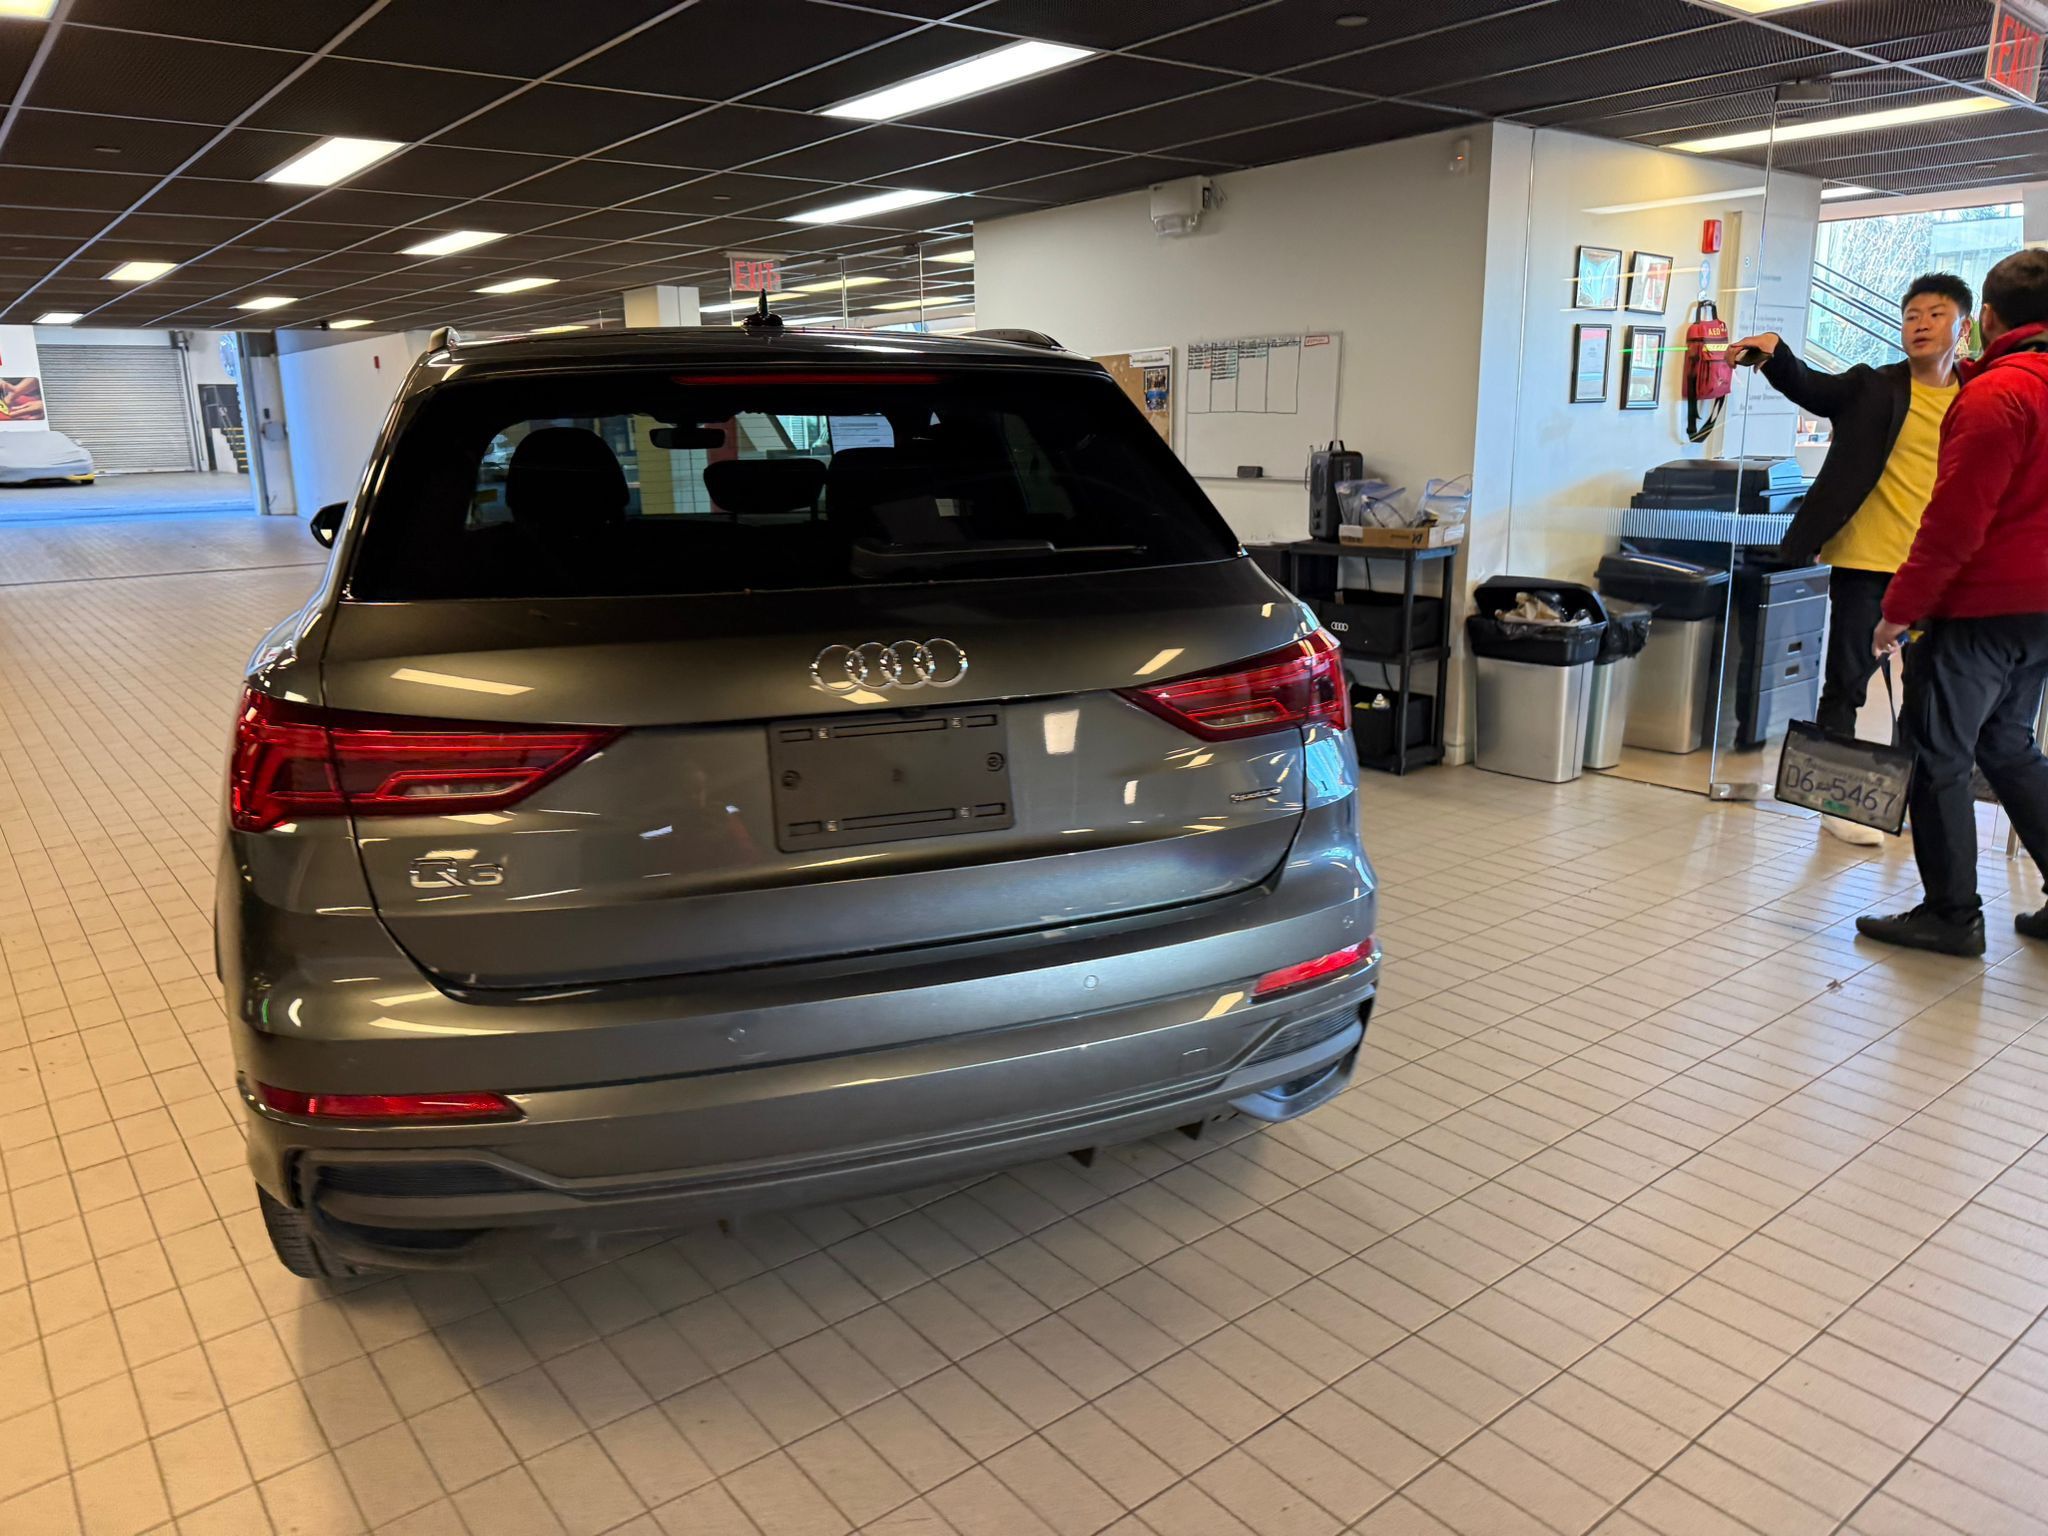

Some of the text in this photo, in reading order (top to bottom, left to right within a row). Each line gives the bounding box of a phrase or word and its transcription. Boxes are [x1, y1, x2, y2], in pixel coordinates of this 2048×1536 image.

[1996, 14, 2040, 97] EXIT
[735, 261, 775, 290] EXIT
[1708, 327, 1721, 336] AED
[409, 857, 504, 889] Q3
